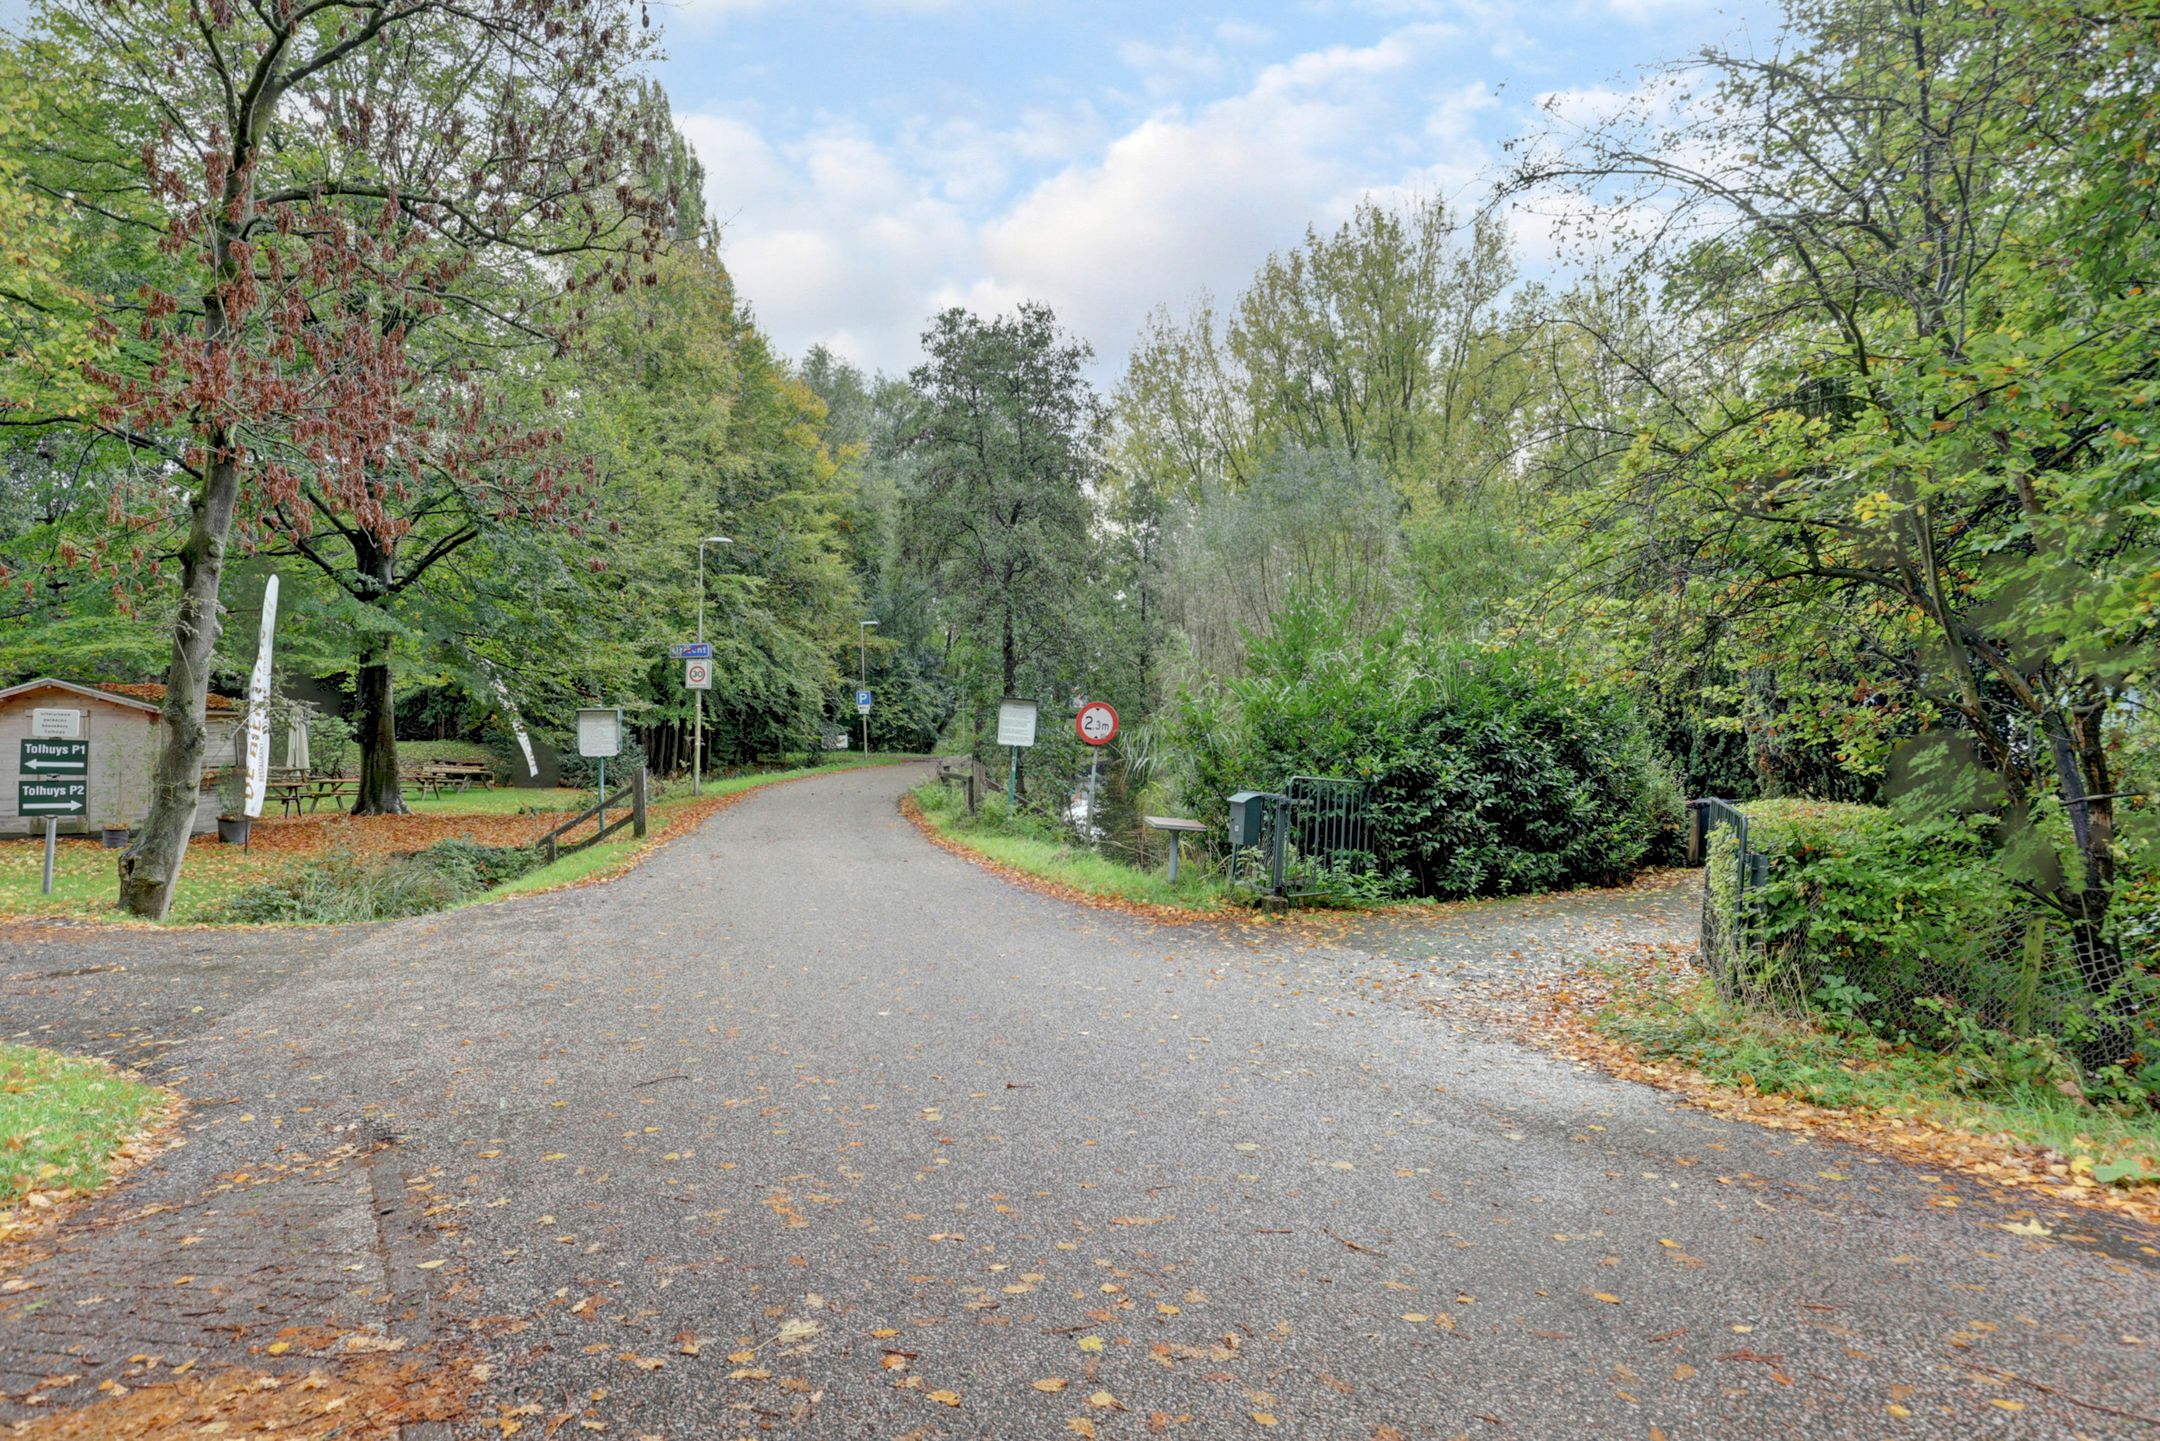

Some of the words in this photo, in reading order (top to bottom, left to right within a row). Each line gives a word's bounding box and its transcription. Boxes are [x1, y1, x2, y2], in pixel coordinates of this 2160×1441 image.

[692, 670, 703, 678] 30
[859, 693, 868, 704] P
[24, 744, 69, 756] Tolhuys
[71, 745, 86, 754] P1
[22, 785, 67, 798] Tolhuys
[69, 785, 85, 795] P2
